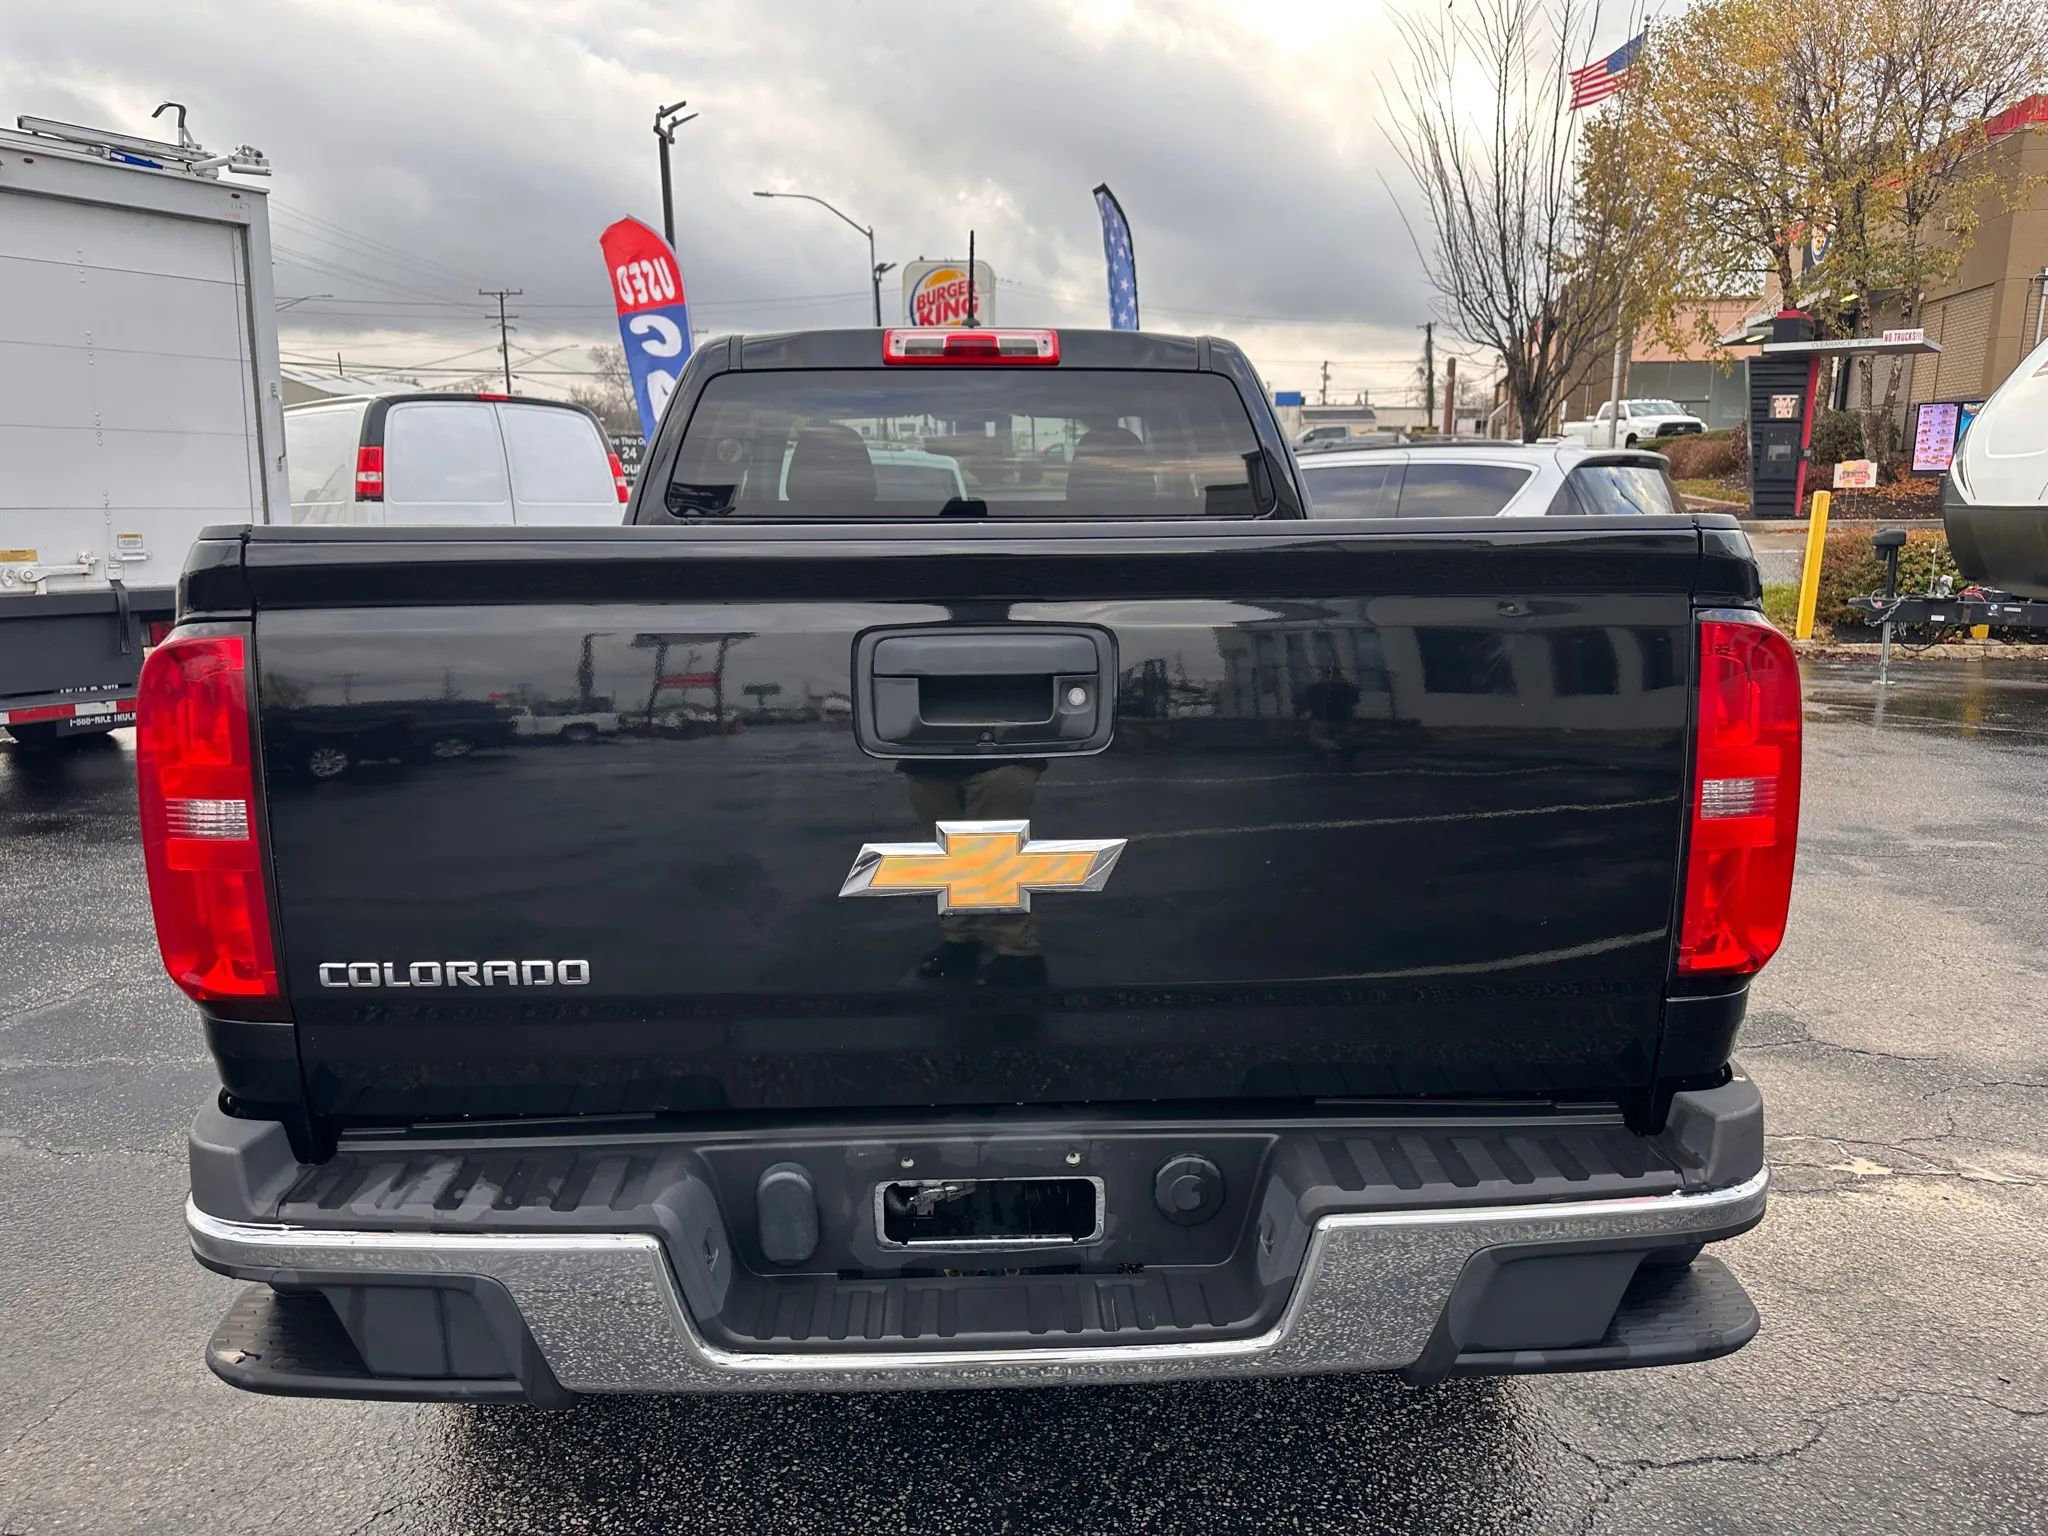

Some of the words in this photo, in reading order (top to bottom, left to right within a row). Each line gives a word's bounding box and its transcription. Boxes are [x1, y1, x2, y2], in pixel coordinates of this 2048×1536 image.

[918, 296, 979, 326] KING
[1884, 332, 1893, 342] NO
[622, 446, 638, 459] 24
[319, 959, 590, 988] COLORADO
